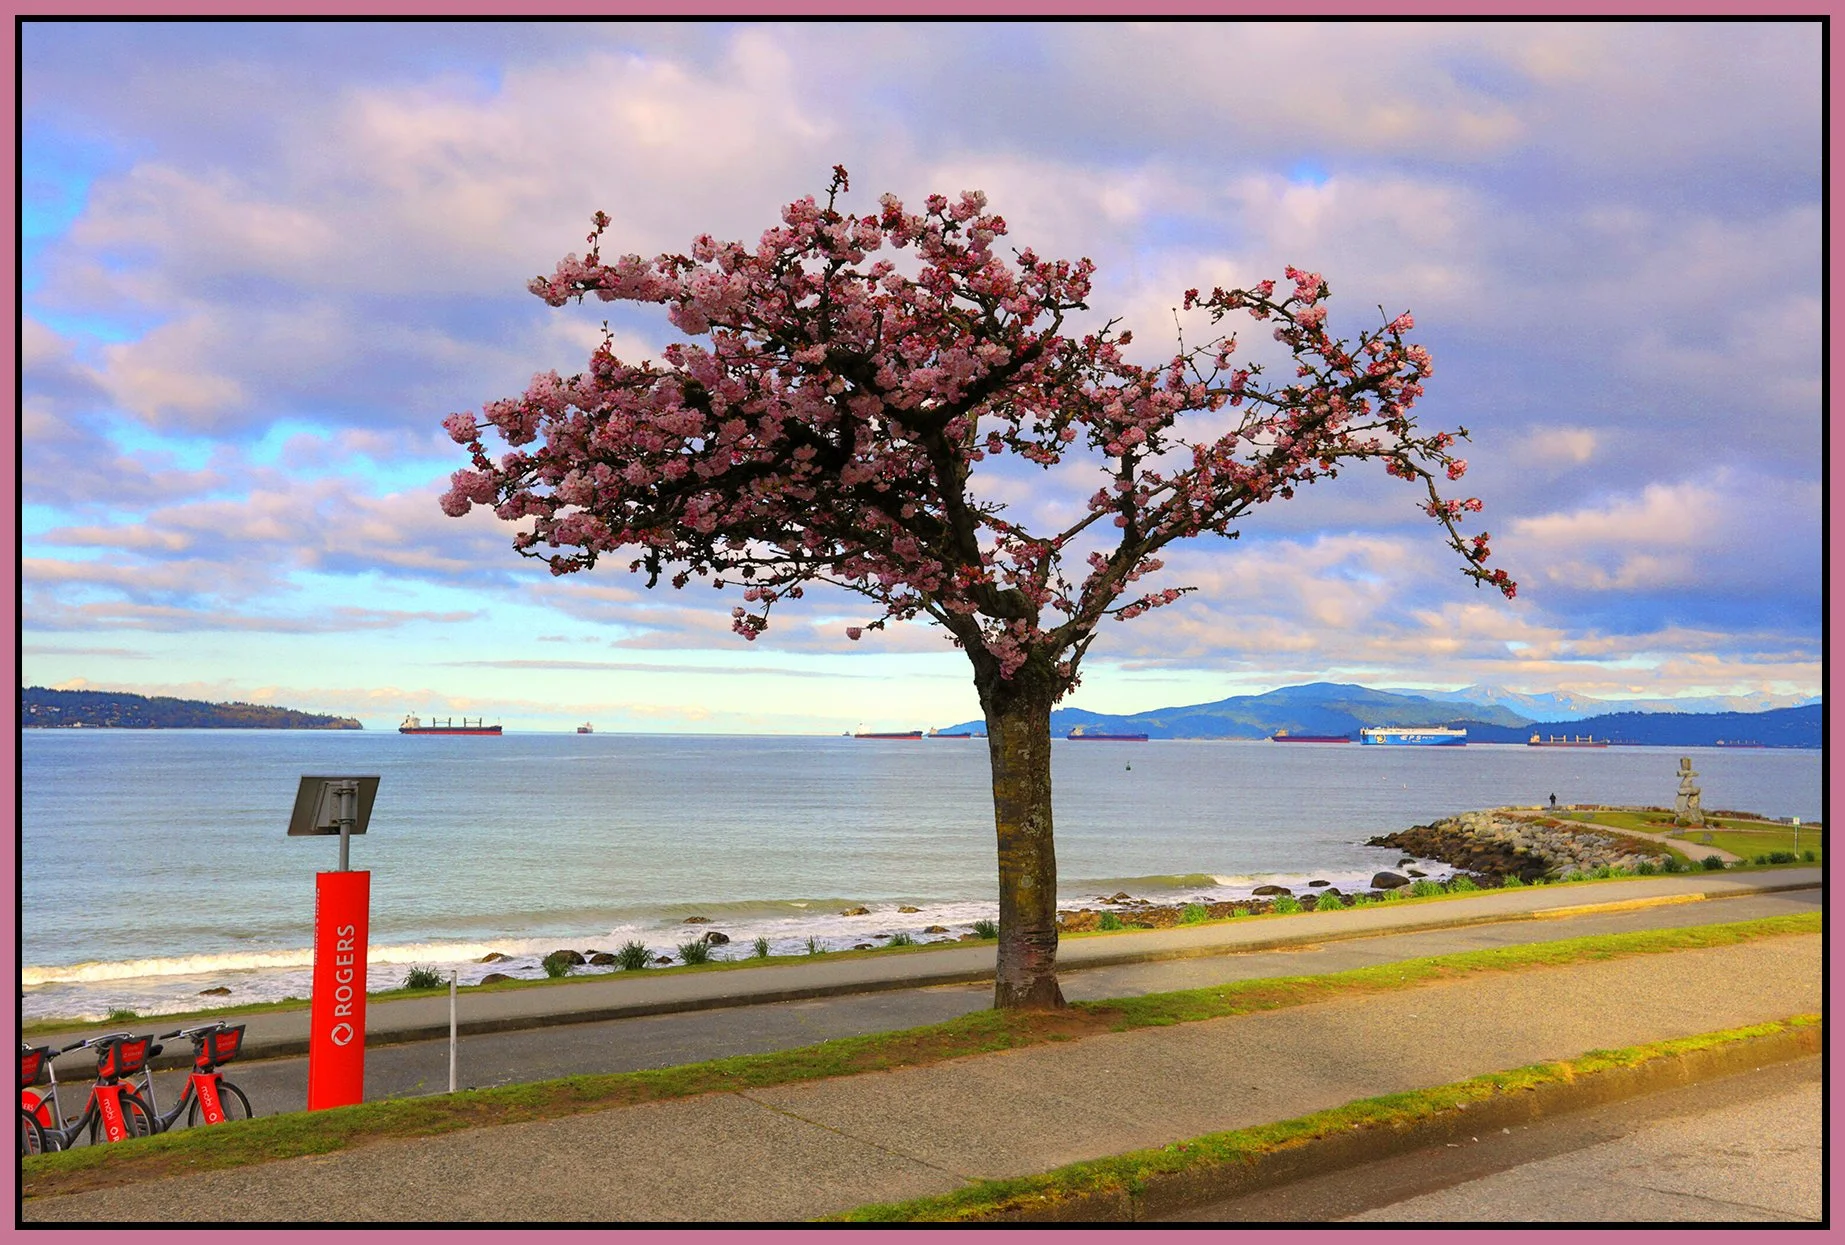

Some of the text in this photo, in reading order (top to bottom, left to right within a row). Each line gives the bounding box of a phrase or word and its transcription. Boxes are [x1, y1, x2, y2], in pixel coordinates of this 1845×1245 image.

[335, 925, 355, 1017] ROGERS
[201, 1086, 213, 1108] mobi
[103, 1098, 115, 1120] mobi
